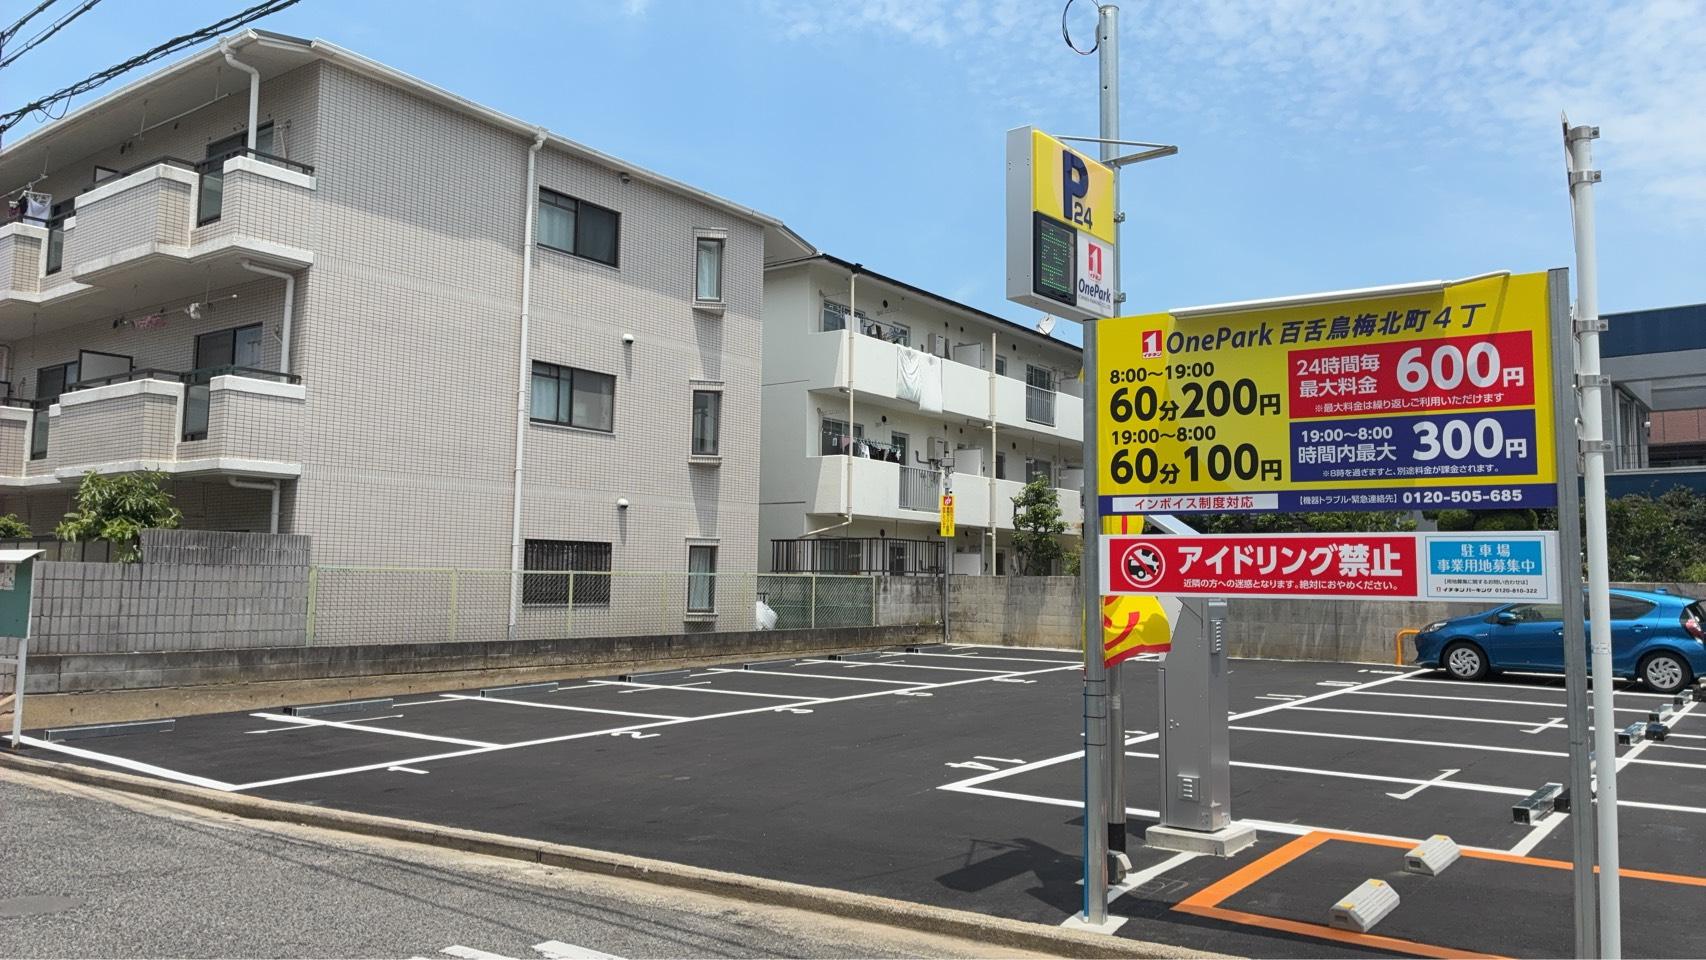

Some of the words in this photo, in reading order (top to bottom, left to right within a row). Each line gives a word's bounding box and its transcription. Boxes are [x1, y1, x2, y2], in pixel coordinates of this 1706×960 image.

[1063, 150, 1089, 220] P
[1074, 202, 1093, 230] 24
[1079, 278, 1111, 303] OnePark
[1166, 322, 1274, 354] OnePark
[1296, 353, 1380, 377] 24時間毎
[1396, 341, 1525, 393] 600円
[1299, 375, 1378, 398] 最大料金
[1412, 418, 1527, 461] 300円
[1298, 442, 1397, 465] 時間内最大
[1135, 496, 1254, 510] インボイス制度対応
[1402, 490, 1523, 504] 0120-505-685
[1178, 543, 1403, 577] アイドリング禁止
[1461, 543, 1511, 558] 駐車場
[1437, 559, 1535, 573] 事業用地募集中
[610, 731, 661, 740] 2
